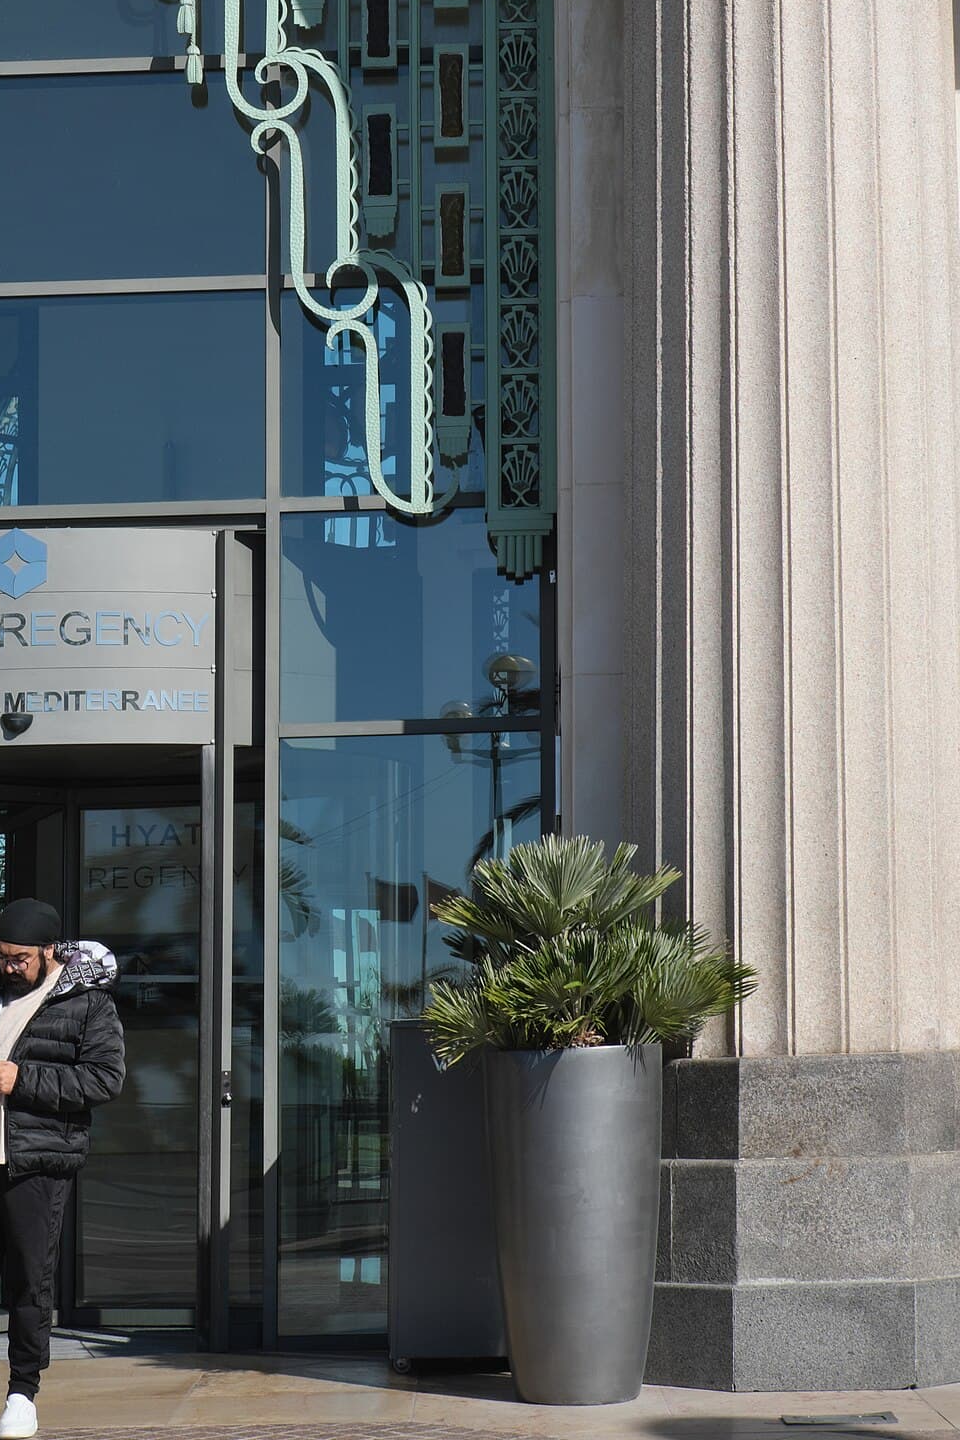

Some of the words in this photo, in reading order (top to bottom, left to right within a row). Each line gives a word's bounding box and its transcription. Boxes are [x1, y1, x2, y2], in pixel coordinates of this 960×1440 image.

[4, 689, 209, 715] MEDITERRANEE
[111, 823, 202, 848] HYAT
[88, 864, 248, 890] REGENY
